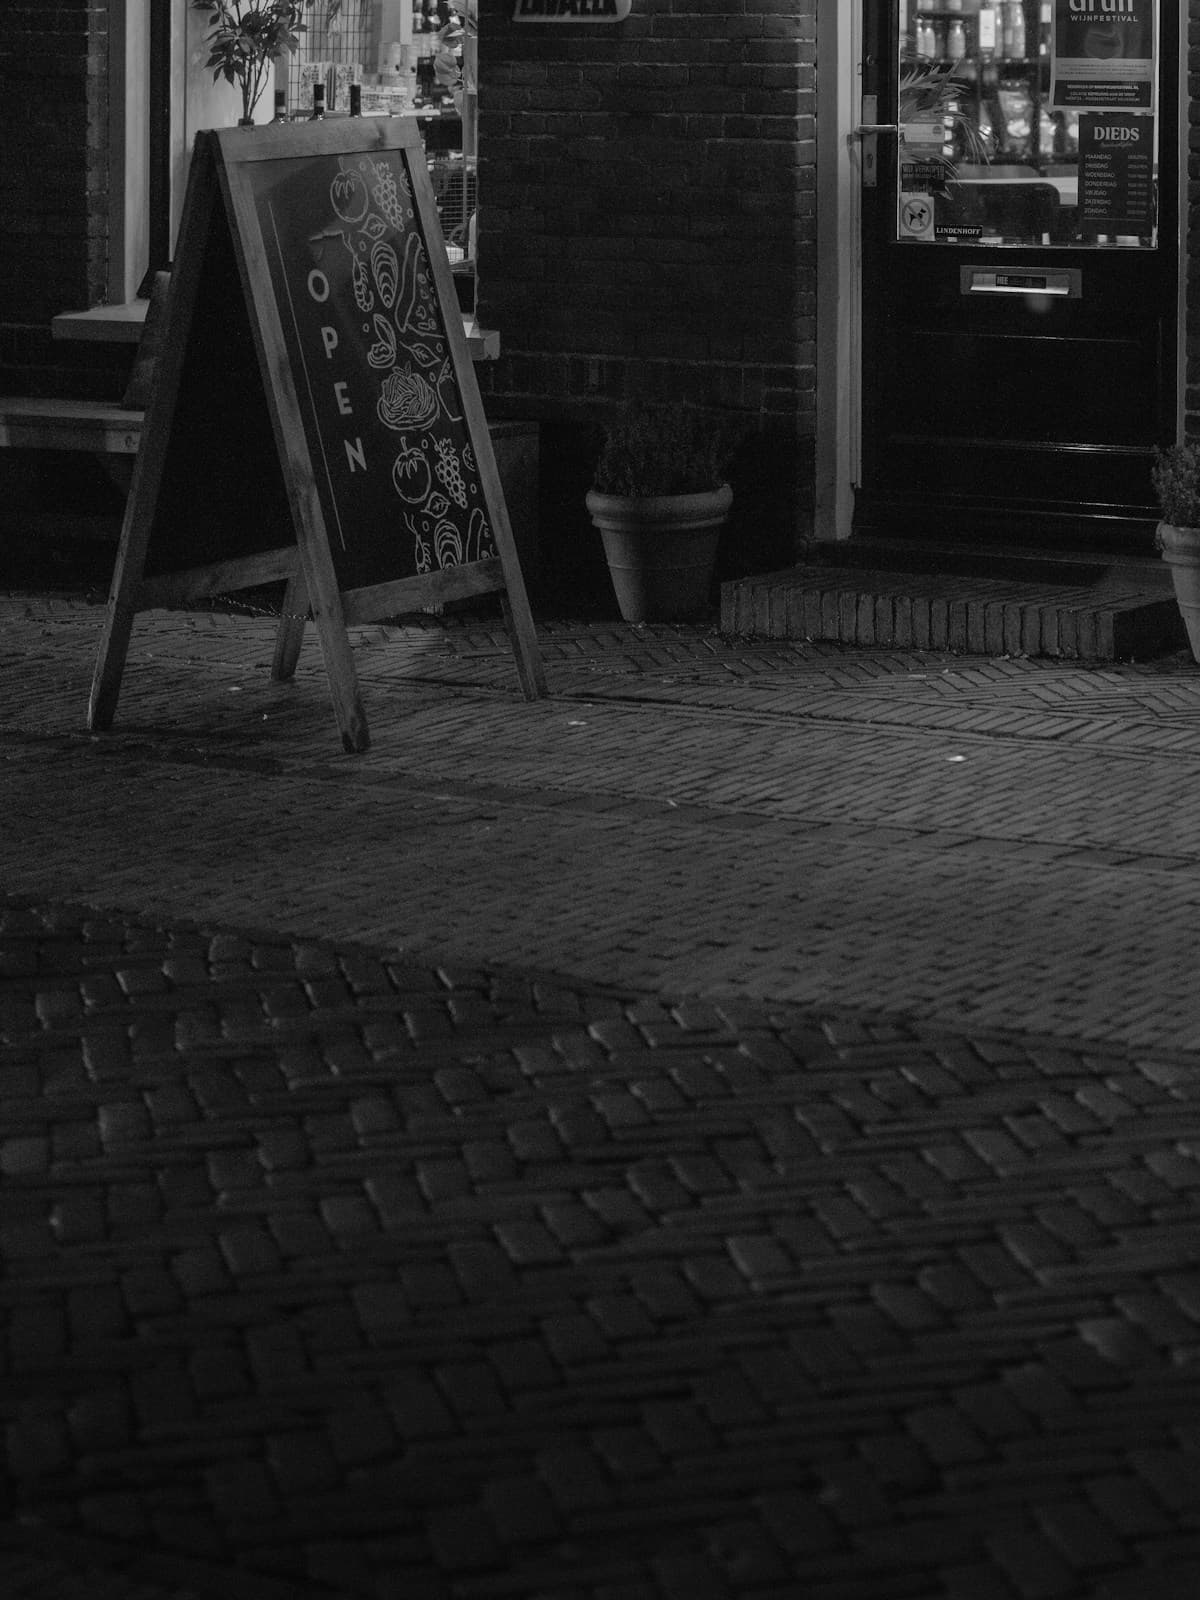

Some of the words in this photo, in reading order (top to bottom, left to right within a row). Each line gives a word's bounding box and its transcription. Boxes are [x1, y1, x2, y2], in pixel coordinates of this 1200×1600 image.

[1070, 14, 1139, 22] WIJNFESTIVAL
[1093, 126, 1140, 141] DIEDS
[936, 226, 981, 235] LINDENHOFF
[307, 268, 368, 473] OPEN
